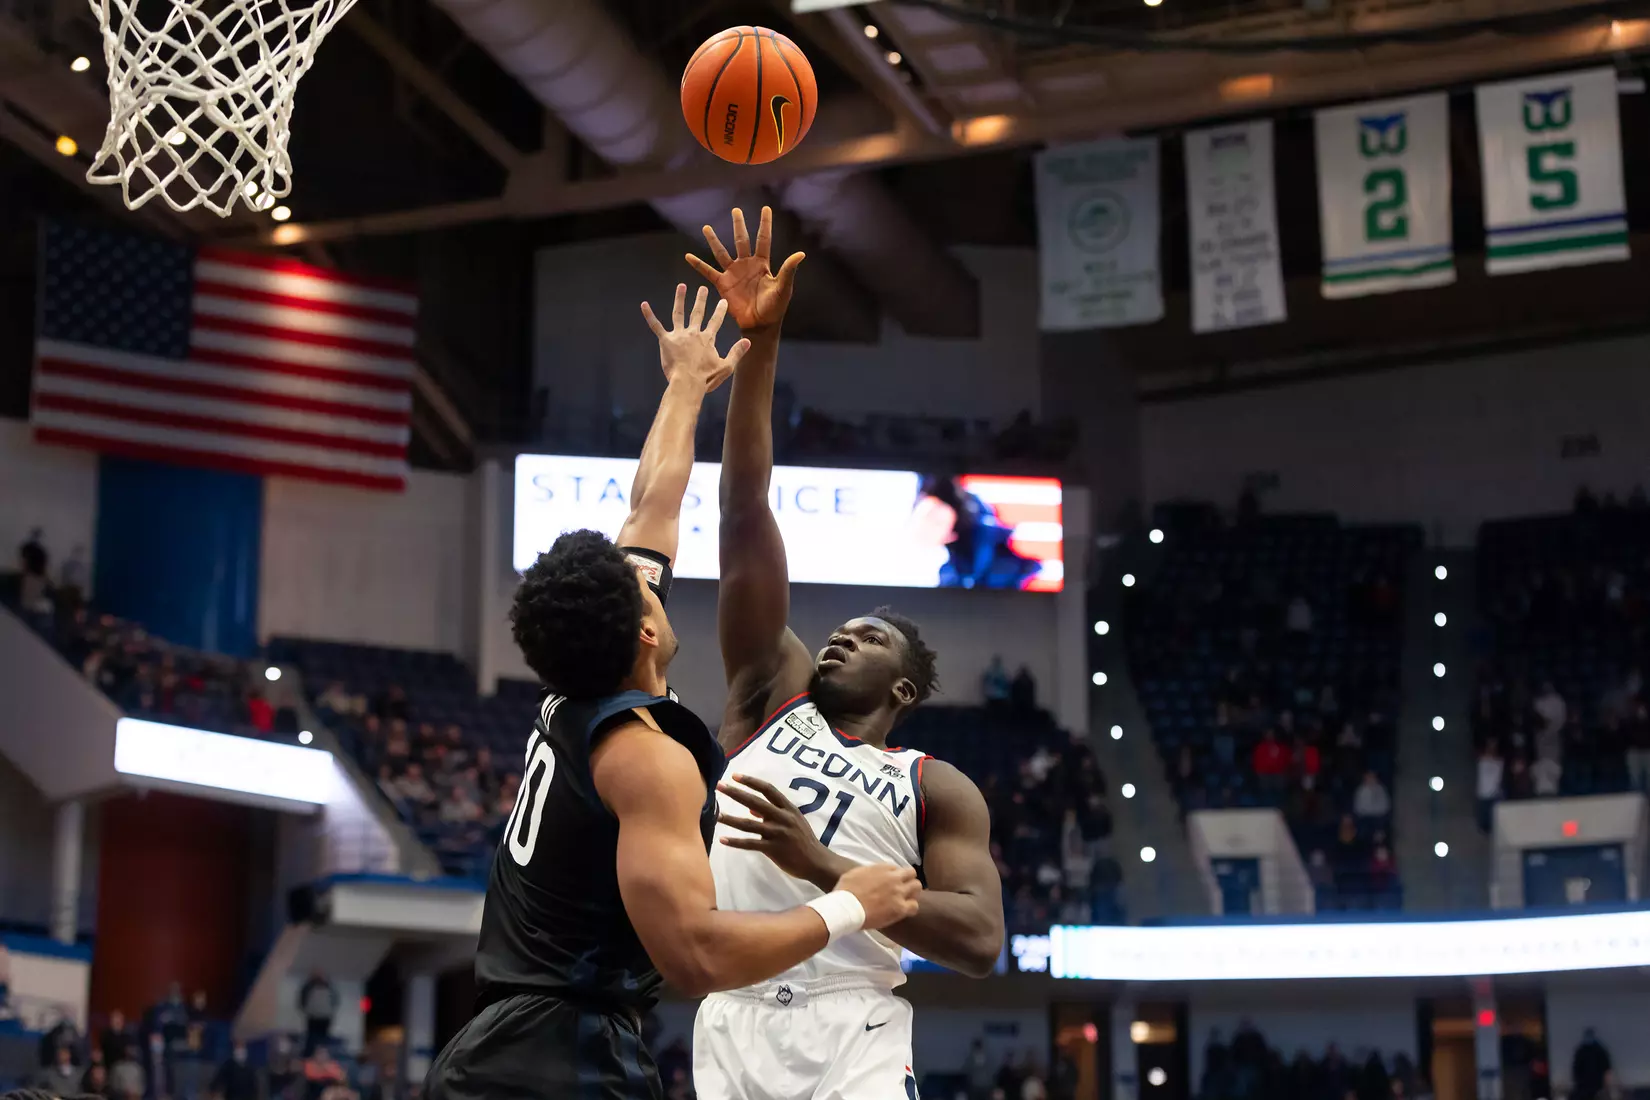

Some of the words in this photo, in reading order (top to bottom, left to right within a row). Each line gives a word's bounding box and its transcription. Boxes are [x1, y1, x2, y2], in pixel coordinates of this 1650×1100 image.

[723, 103, 739, 145] UCONN
[1364, 168, 1408, 242] 2
[1527, 140, 1579, 210] 5
[532, 474, 701, 508] STAS
[766, 726, 911, 818] UCONN
[788, 776, 856, 848] 21
